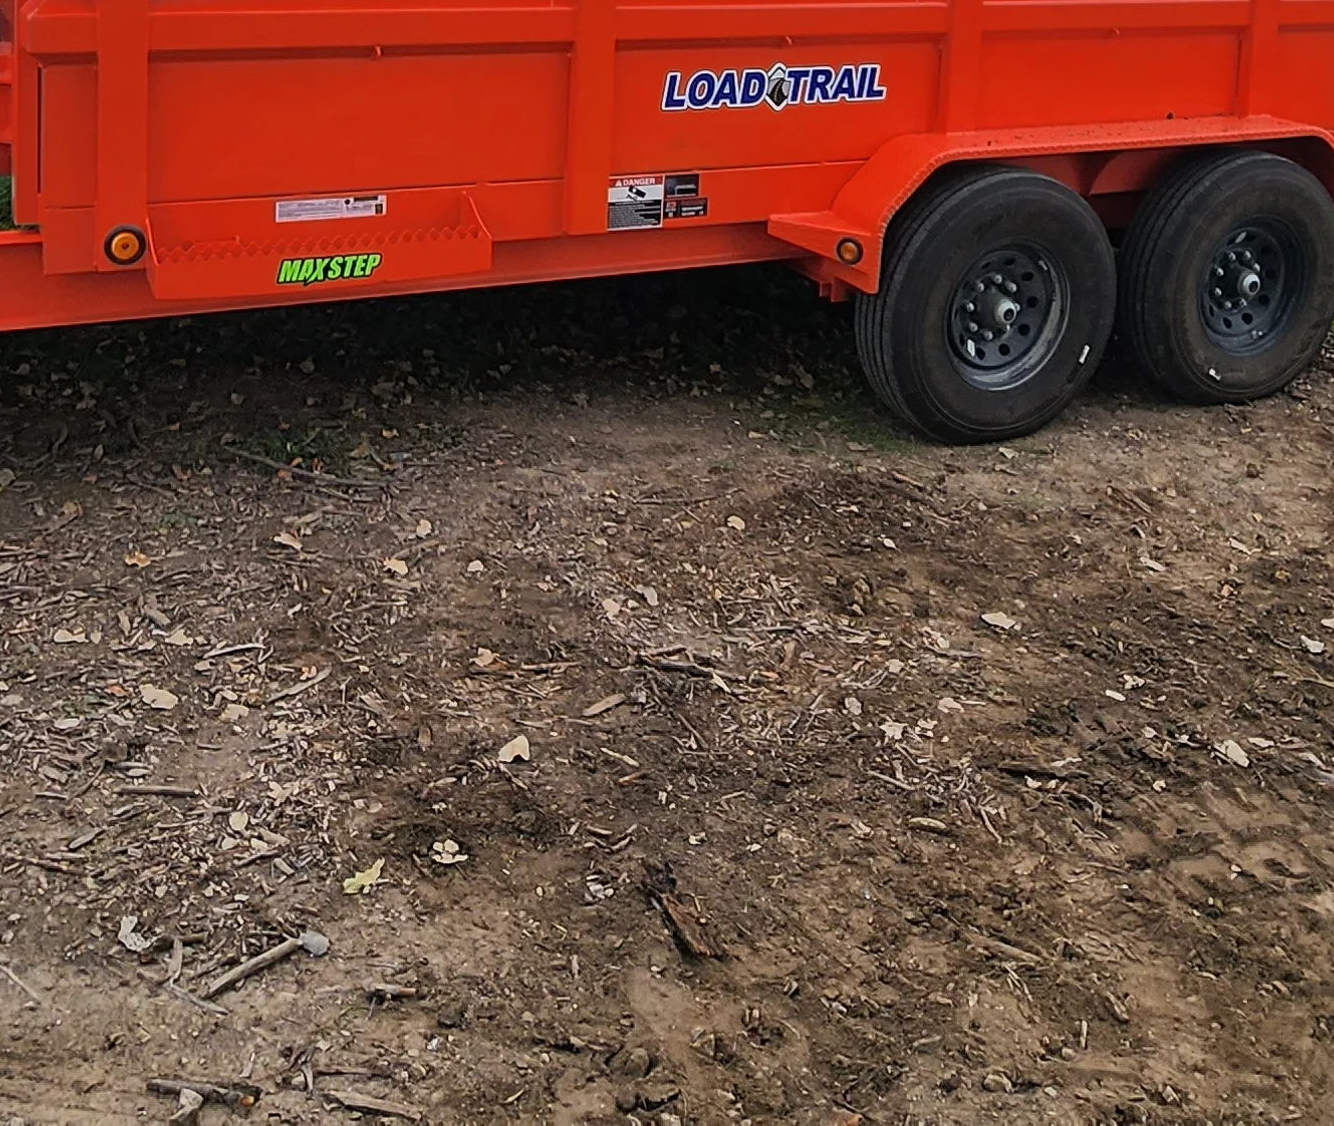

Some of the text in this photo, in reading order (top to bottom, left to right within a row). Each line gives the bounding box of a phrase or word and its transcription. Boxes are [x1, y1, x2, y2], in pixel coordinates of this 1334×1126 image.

[663, 66, 884, 108] LOAD TRAIL
[622, 177, 656, 186] DANGER
